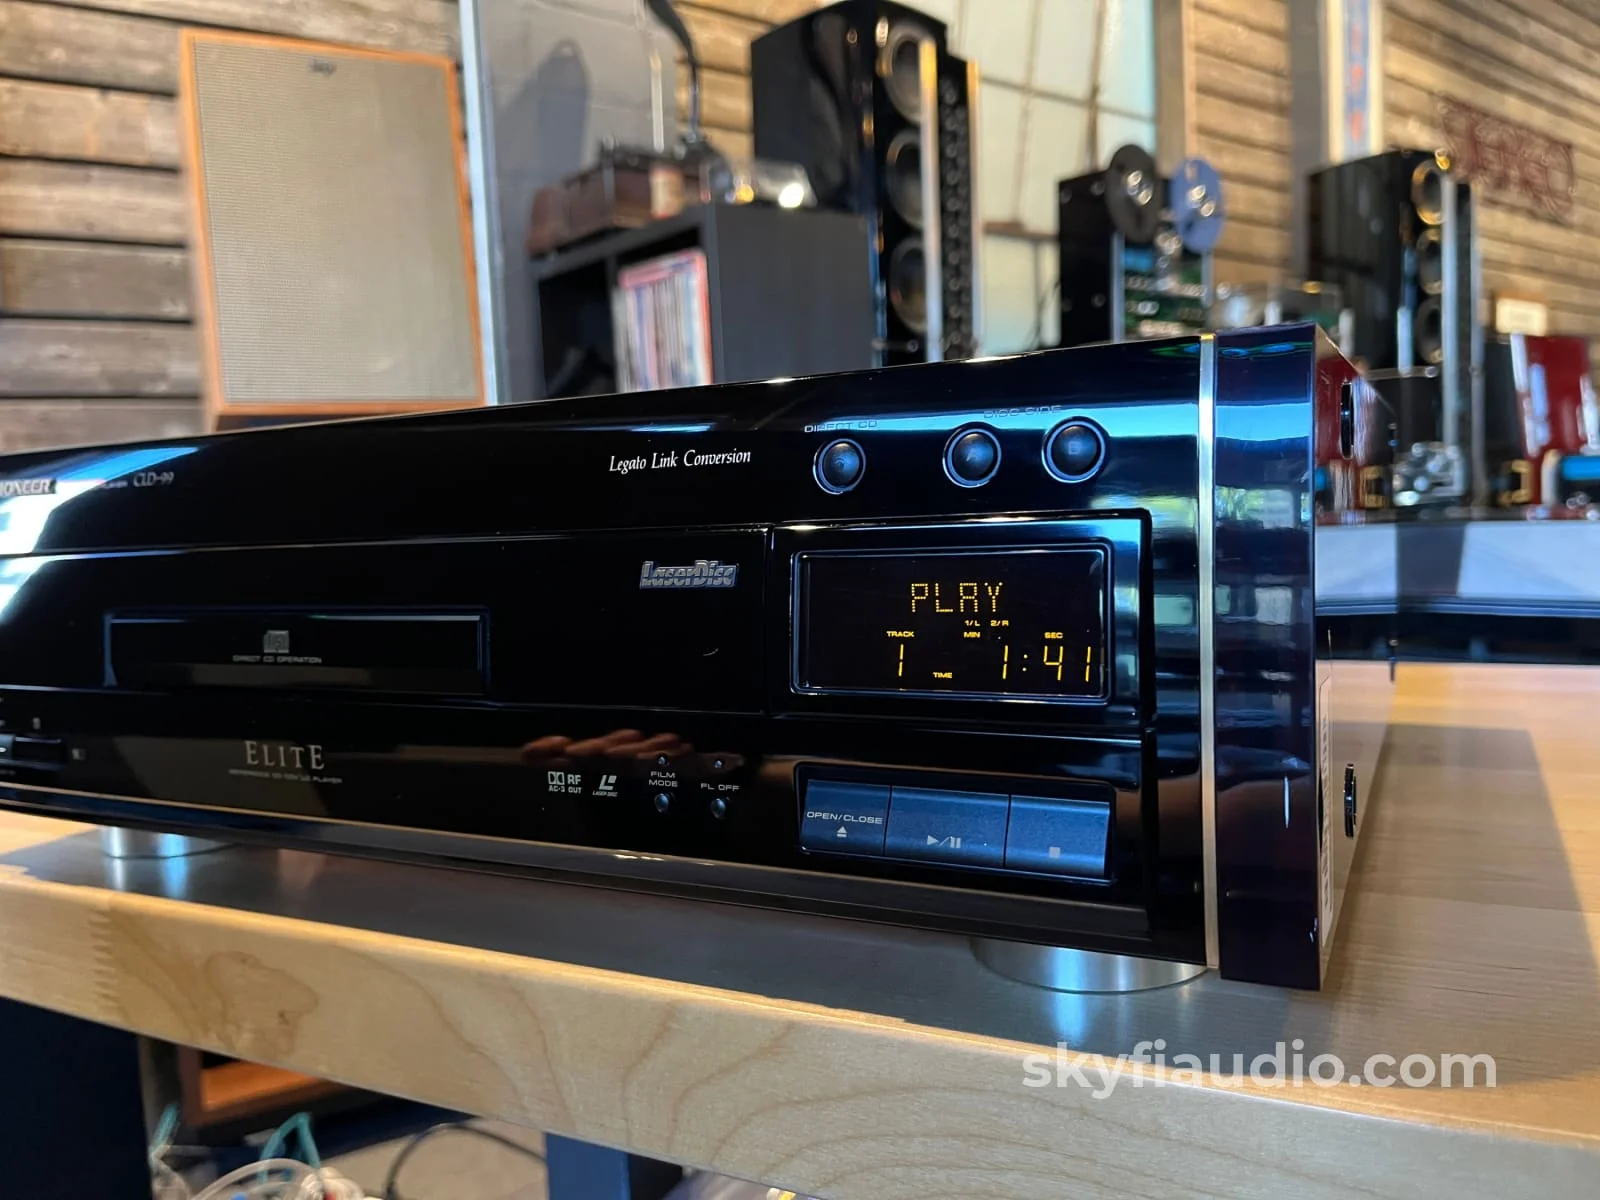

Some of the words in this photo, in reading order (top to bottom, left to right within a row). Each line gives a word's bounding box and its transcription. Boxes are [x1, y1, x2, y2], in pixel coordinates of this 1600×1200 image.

[984, 407, 1020, 419] DISC
[1025, 404, 1063, 415] SIDE
[804, 422, 852, 433] DIRECT
[858, 420, 877, 429] CD
[609, 455, 647, 475] Legato
[651, 450, 679, 469] Link
[683, 448, 751, 466] Conversion
[133, 471, 174, 487] CLD-99
[0, 478, 50, 497] IONEER
[911, 582, 1003, 613] PLAY
[886, 630, 915, 638] TRACK
[963, 631, 980, 639] MIN
[1044, 631, 1063, 640] SEC
[898, 643, 904, 677] 1
[932, 671, 953, 679] TIME
[244, 740, 325, 770] ELITE
[567, 774, 582, 785] RF
[648, 779, 678, 788] MODE
[568, 786, 582, 794] OUT
[718, 784, 740, 792] OFF
[806, 811, 883, 825] OPEN/CLOSE
